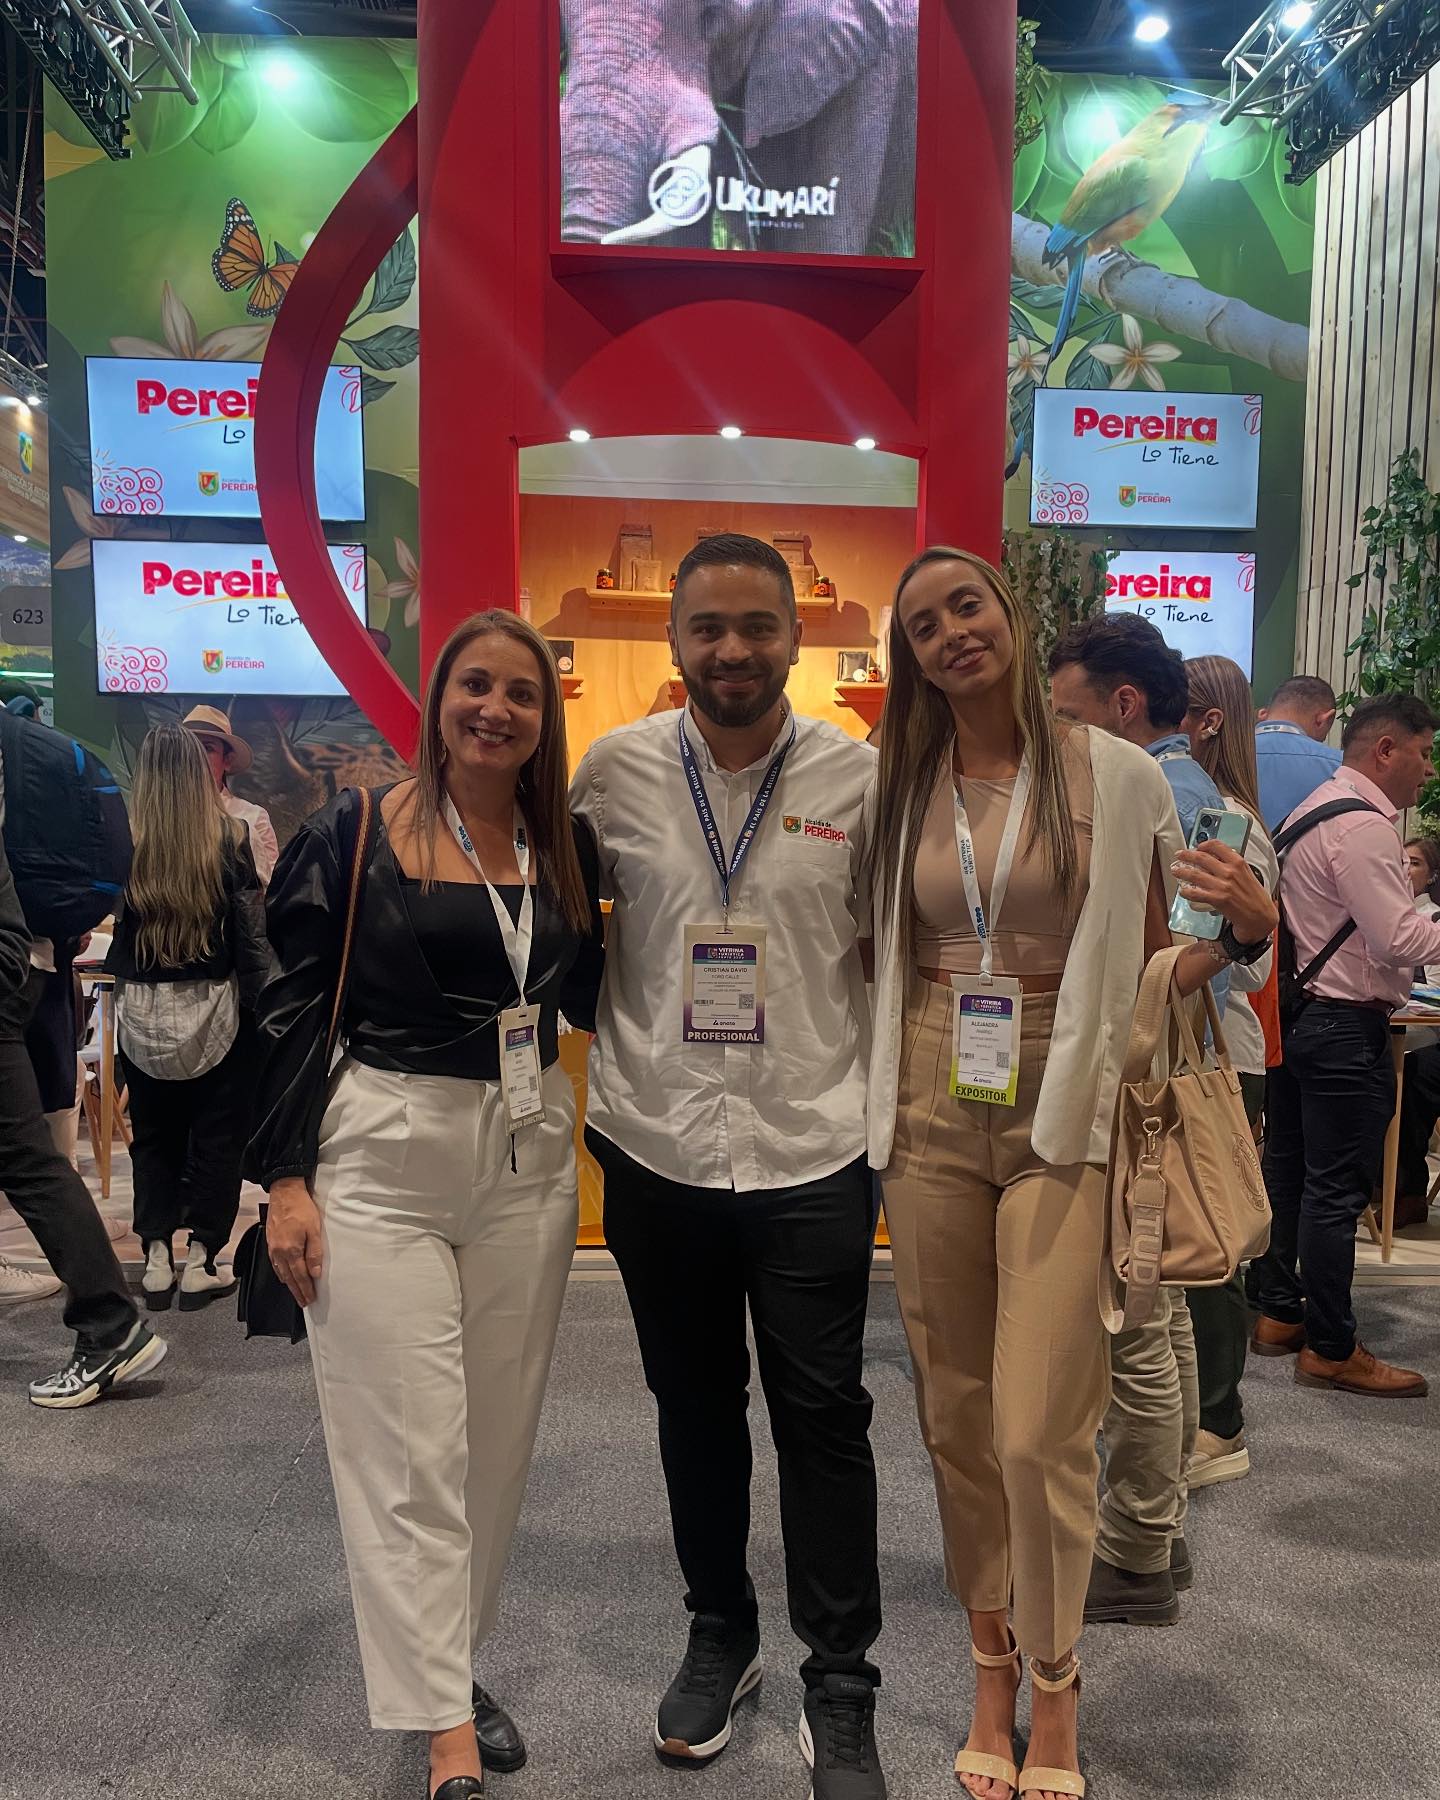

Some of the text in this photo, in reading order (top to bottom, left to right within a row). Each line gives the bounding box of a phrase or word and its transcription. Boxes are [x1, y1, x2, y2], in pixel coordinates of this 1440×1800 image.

[716, 176, 840, 217] UKUMARÍ
[136, 379, 260, 418] Perei
[1073, 405, 1218, 442] Pereira
[223, 425, 246, 444] Lo
[1142, 445, 1219, 466] Lo Tiene
[221, 482, 257, 491] PEREIR
[1137, 495, 1171, 504] PEREIRA
[142, 559, 281, 598] Pereir
[1105, 565, 1212, 599] ereira
[12, 608, 44, 625] 623
[227, 604, 303, 626] Lo Tien
[1163, 604, 1214, 623] Tiene
[225, 660, 265, 669] PEREIRA
[804, 824, 846, 842] PEREIRA
[687, 1031, 760, 1042] PROFESIONAL
[955, 1085, 1007, 1102] EXPOSITOR
